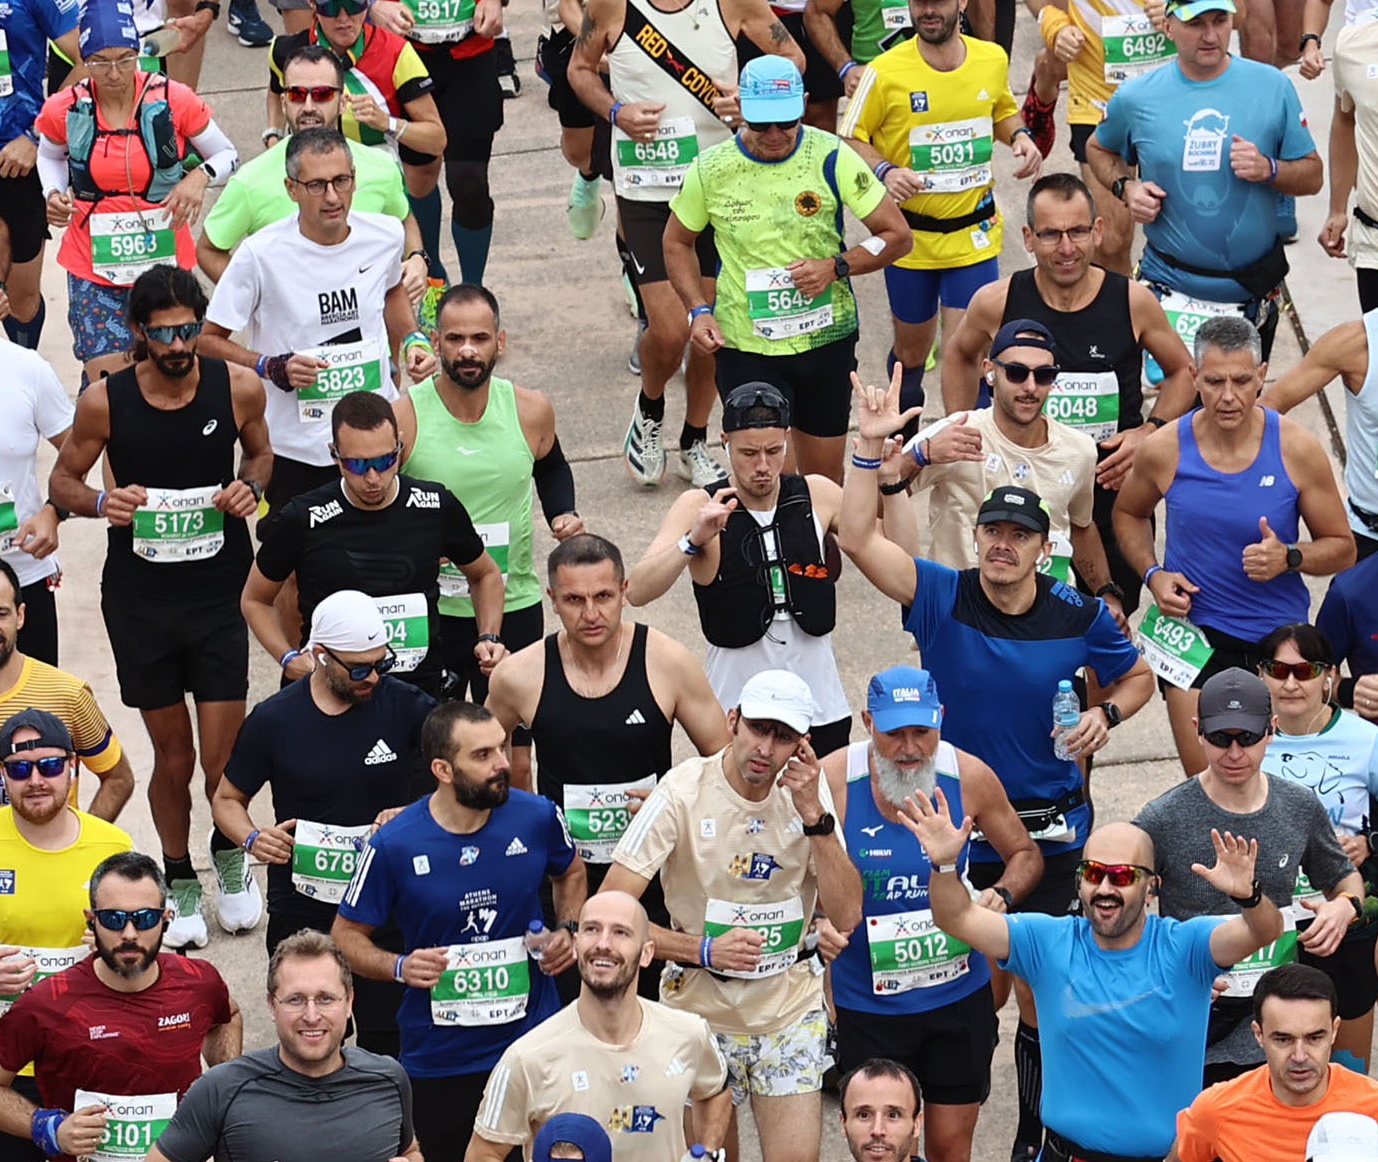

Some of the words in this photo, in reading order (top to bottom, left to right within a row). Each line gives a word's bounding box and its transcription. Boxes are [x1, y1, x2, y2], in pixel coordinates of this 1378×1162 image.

[636, 25, 666, 60] RED
[1122, 36, 1166, 56] 6492
[634, 139, 680, 160] 6548
[929, 139, 975, 163] 5031
[318, 288, 358, 312] BAM
[317, 367, 366, 392] 5823
[1048, 396, 1097, 417] 6048
[155, 512, 204, 534] 5173
[1153, 616, 1194, 651] 6493
[892, 688, 919, 697] ITALIA
[365, 751, 397, 765] adidas
[895, 935, 947, 962] 5012
[454, 968, 509, 993] 6310
